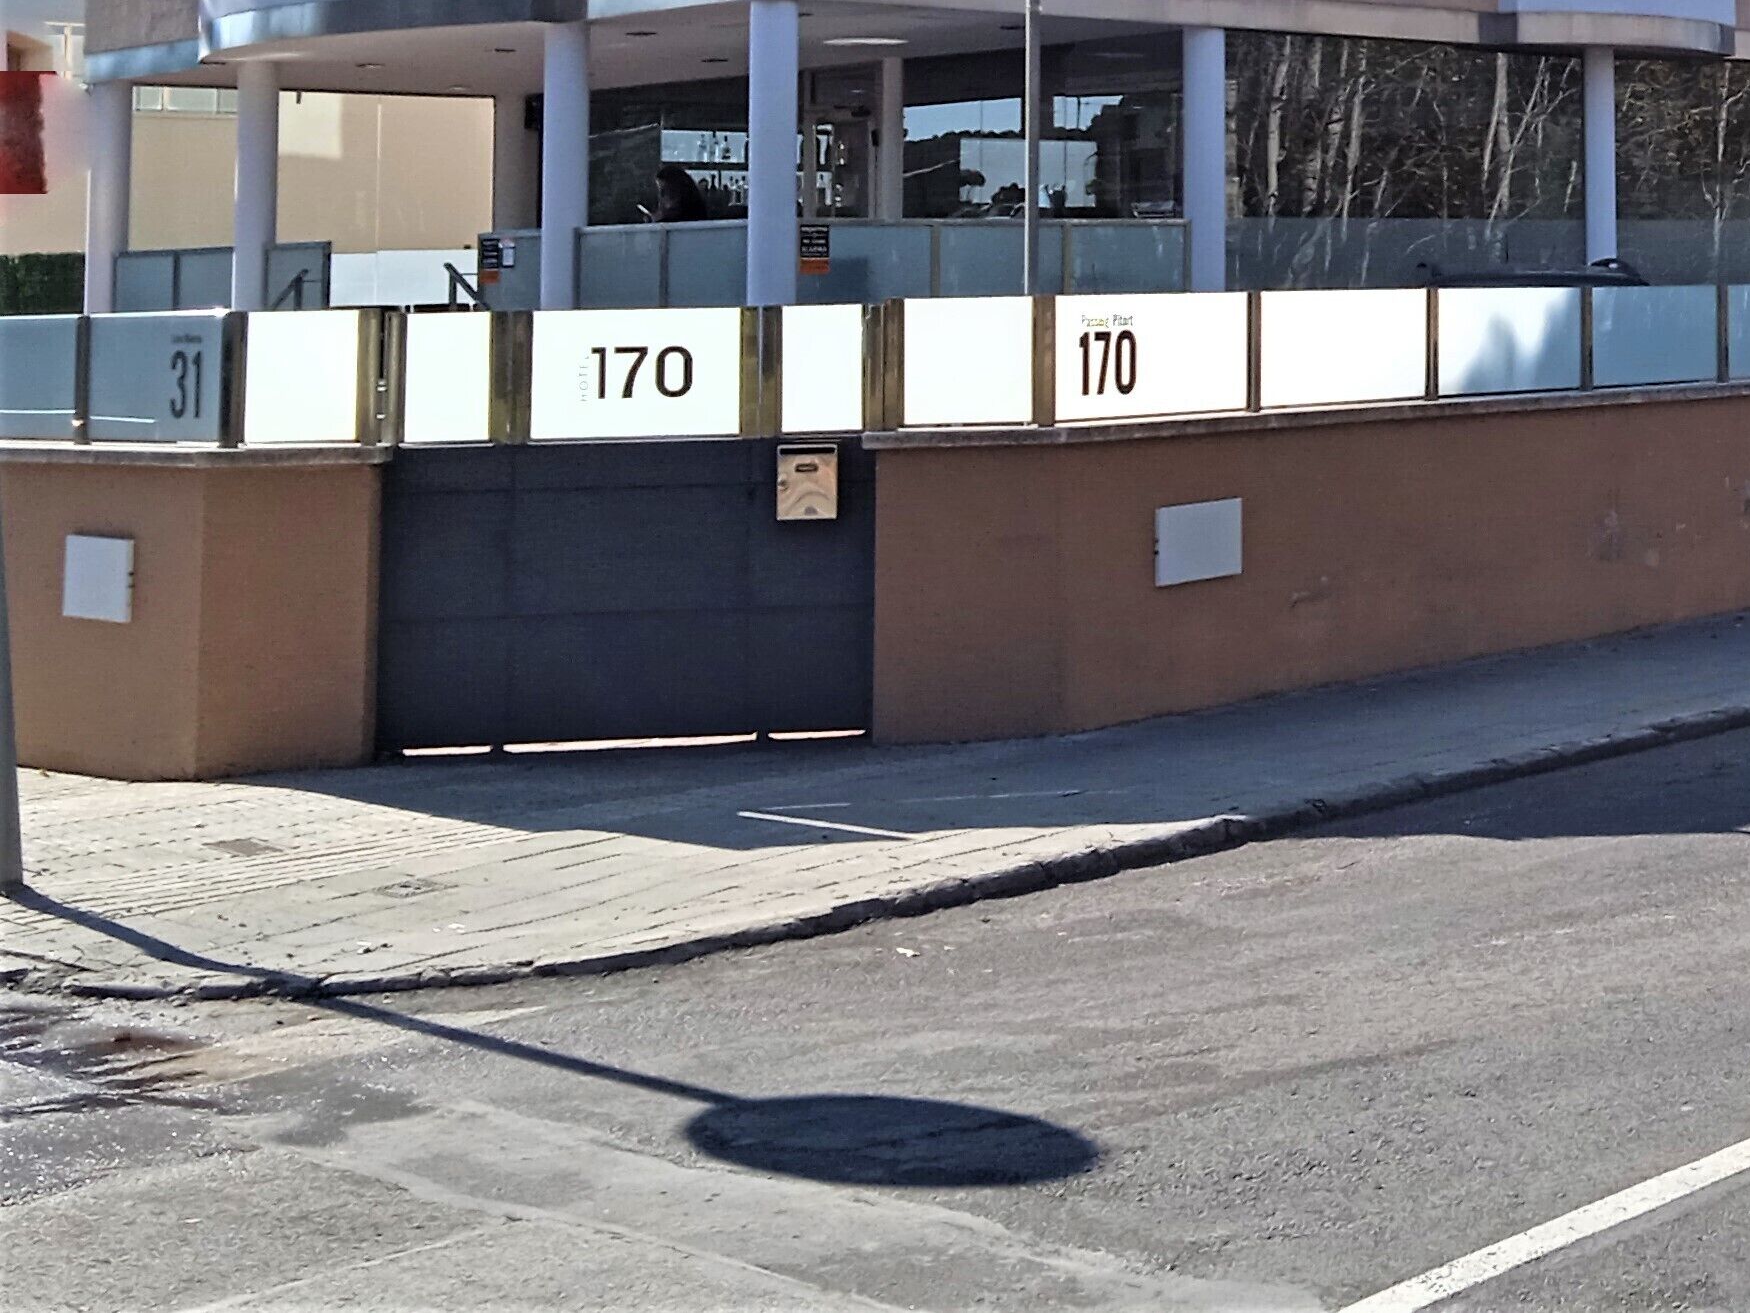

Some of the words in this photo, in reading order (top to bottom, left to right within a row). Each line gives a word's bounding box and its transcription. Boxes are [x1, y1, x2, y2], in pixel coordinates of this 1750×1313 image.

[170, 350, 202, 419] 31
[591, 345, 693, 399] 170
[1079, 330, 1137, 395] 170
